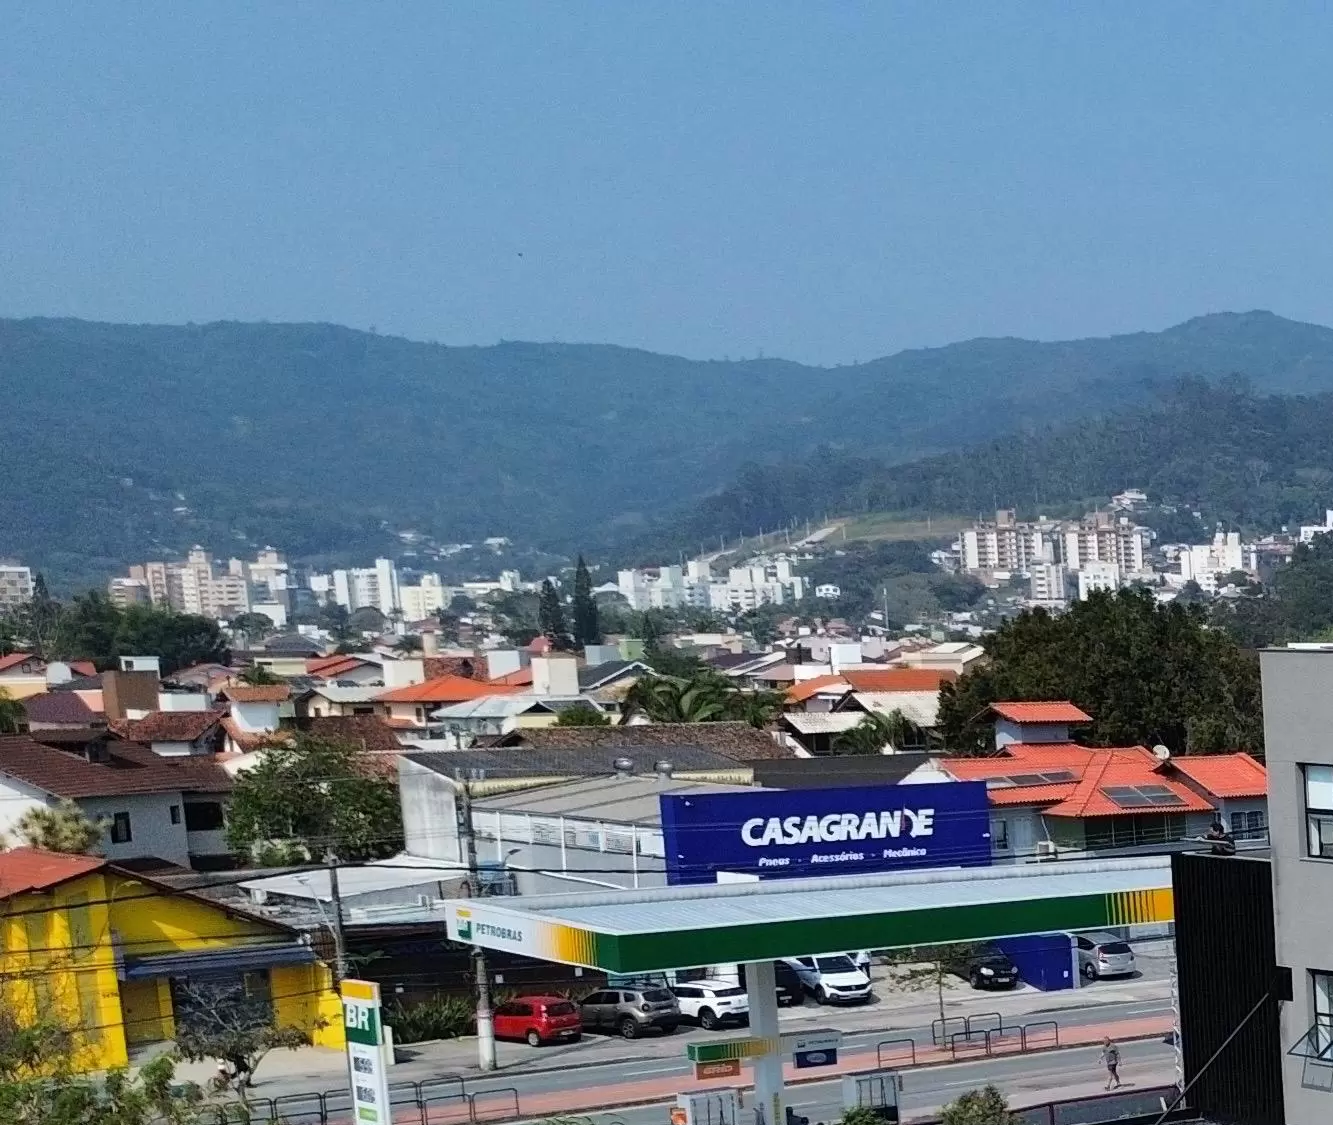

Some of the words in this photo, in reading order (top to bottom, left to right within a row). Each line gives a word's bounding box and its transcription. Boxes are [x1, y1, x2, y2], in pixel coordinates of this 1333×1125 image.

[741, 805, 935, 847] CASAGRANDE
[758, 856, 790, 867] Pneus
[810, 850, 865, 864] Acessórios
[475, 921, 523, 942] PETROBRAS
[346, 1004, 370, 1032] BR
